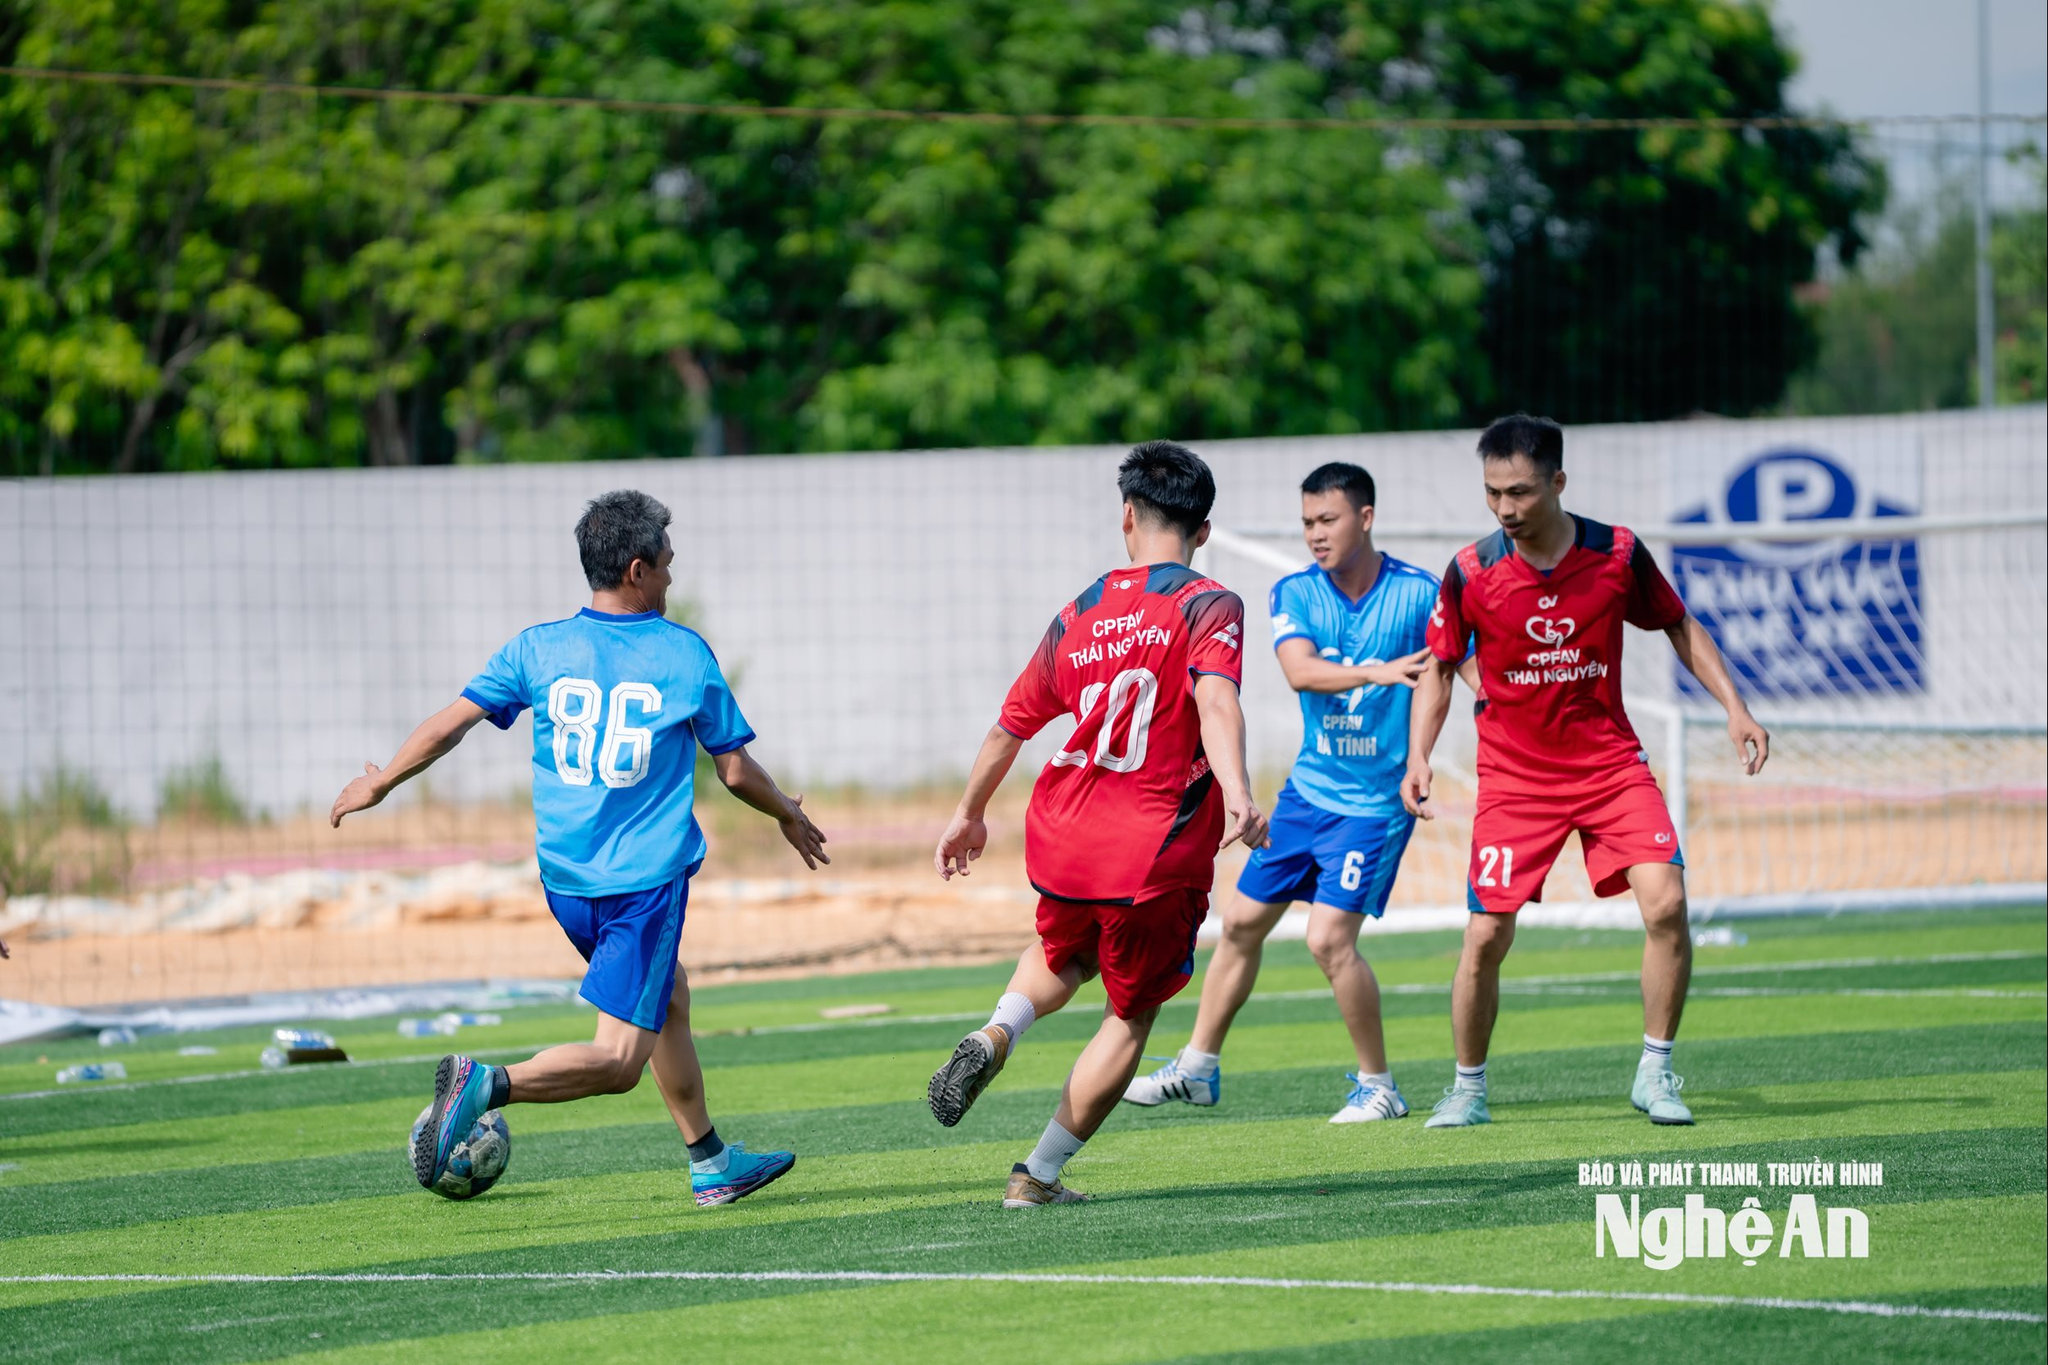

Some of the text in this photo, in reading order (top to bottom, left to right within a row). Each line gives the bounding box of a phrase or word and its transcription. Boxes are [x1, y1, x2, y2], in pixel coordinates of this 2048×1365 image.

[1756, 457, 1836, 526] P
[1092, 608, 1145, 638] CPFAV
[1068, 641, 1103, 669] THÁI
[1526, 649, 1581, 667] CPFAV
[1543, 660, 1608, 684] NGUYÊN
[547, 677, 663, 788] 86
[1050, 667, 1158, 773] 20
[1322, 714, 1364, 731] CPFAV
[1335, 733, 1377, 757] TĨNH
[1339, 850, 1365, 891] 6
[1477, 846, 1514, 888] 21
